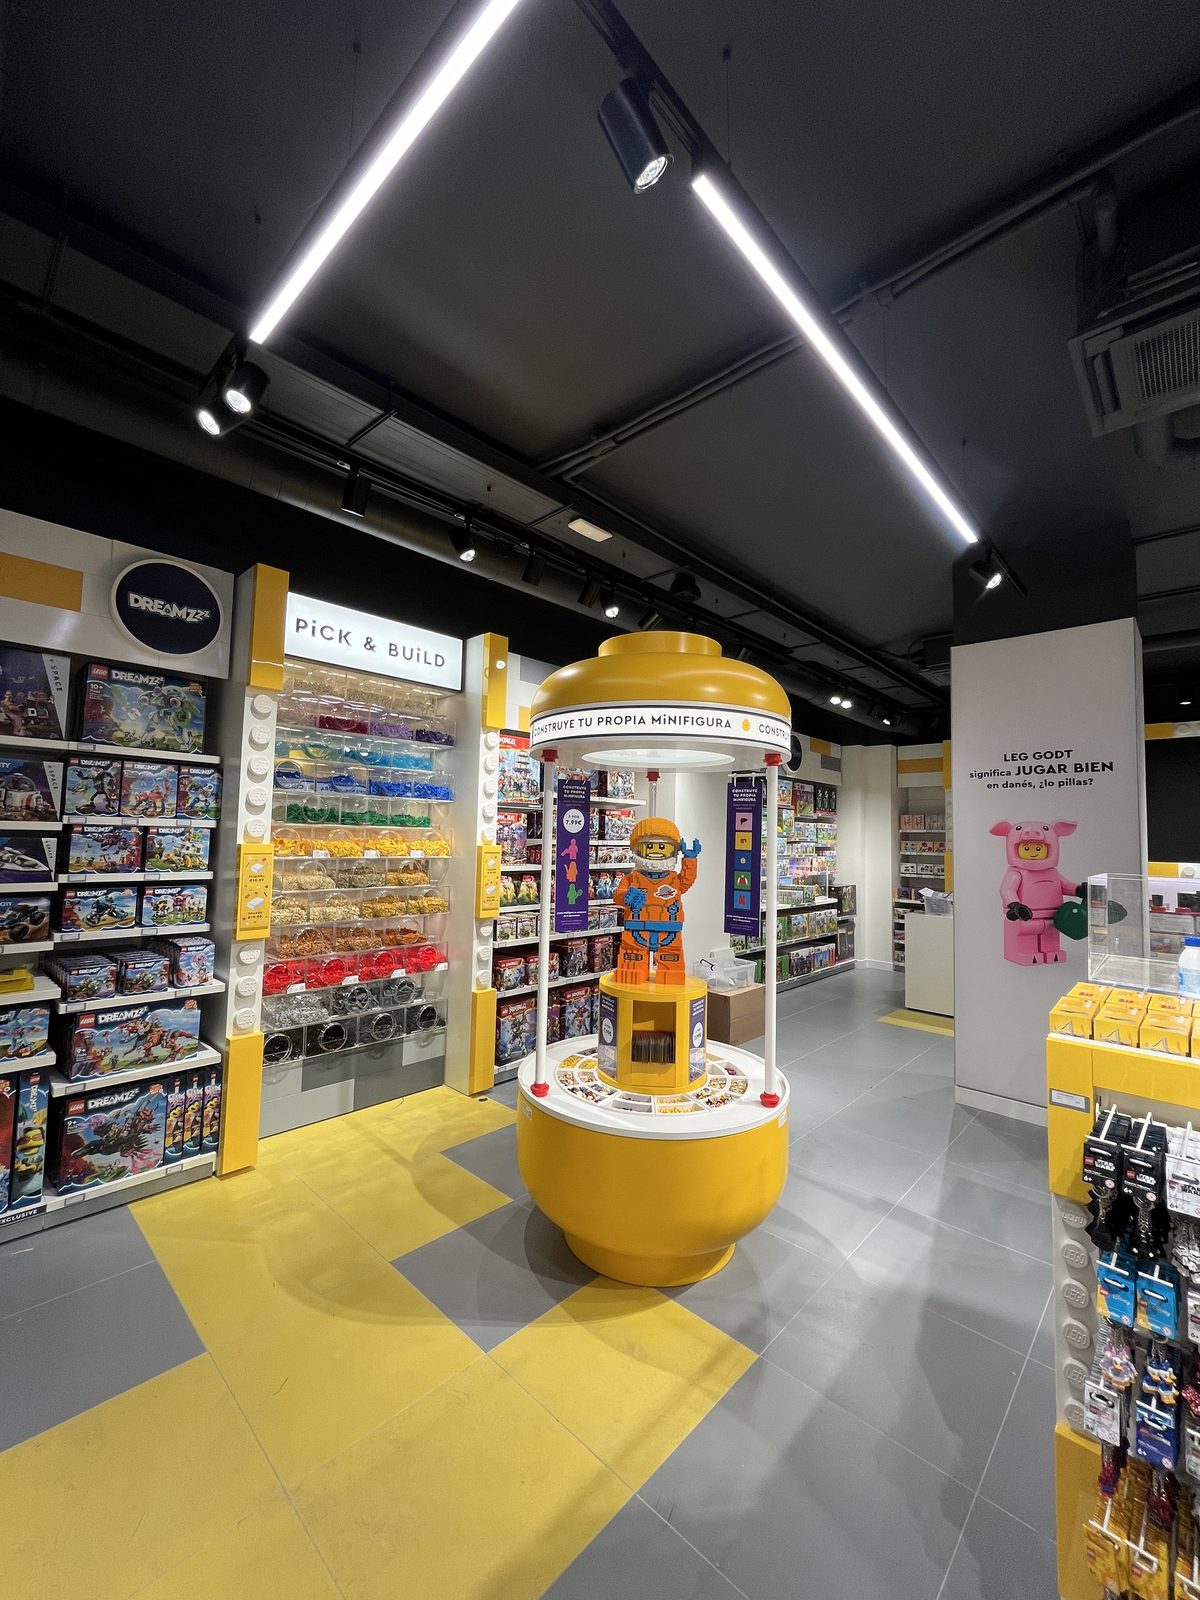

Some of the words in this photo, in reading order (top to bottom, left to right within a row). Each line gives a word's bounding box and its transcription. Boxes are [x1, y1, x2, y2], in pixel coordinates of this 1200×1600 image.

[363, 636, 377, 652] &
[577, 717, 592, 728] TU
[597, 715, 647, 726] PROPIA
[1003, 752, 1029, 762] LEG
[1032, 749, 1074, 760] GODT
[969, 767, 1012, 779] significa
[1014, 762, 1068, 777] JUGAR
[1073, 761, 1114, 774] BIEN
[986, 782, 999, 790] en
[1001, 779, 1036, 790] danés,
[1058, 777, 1094, 789] pillas?
[1063, 1248, 1084, 1264] LEGO
[1064, 1288, 1085, 1304] LEGO
[1066, 1328, 1087, 1345] LEGO
